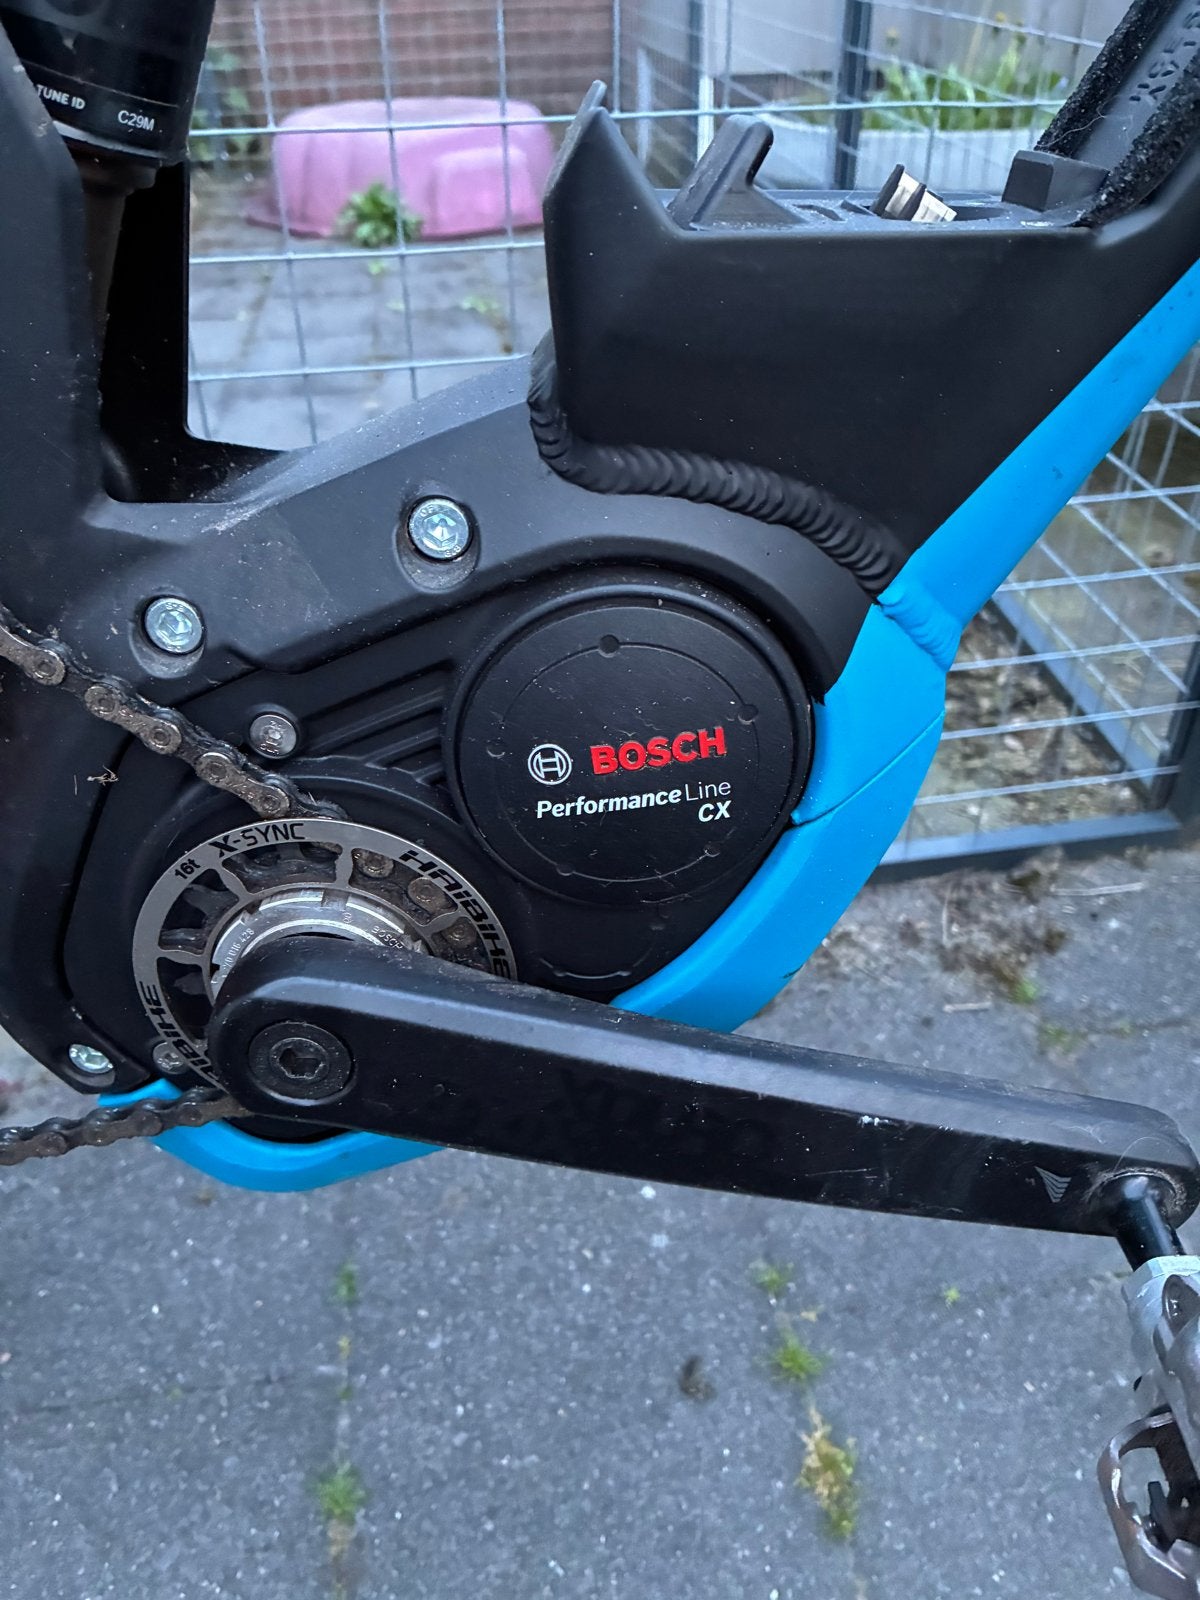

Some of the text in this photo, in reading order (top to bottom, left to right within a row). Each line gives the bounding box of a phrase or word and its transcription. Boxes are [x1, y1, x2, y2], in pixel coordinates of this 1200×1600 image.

[37, 84, 155, 131] TUNE ID C29M
[590, 725, 726, 775] BOSCH
[536, 781, 732, 819] Performance Line
[698, 800, 732, 823] CX
[174, 823, 306, 880] 16t X-SYNC
[371, 925, 404, 950] BOSCH
[139, 980, 221, 1084] AIBIKE
